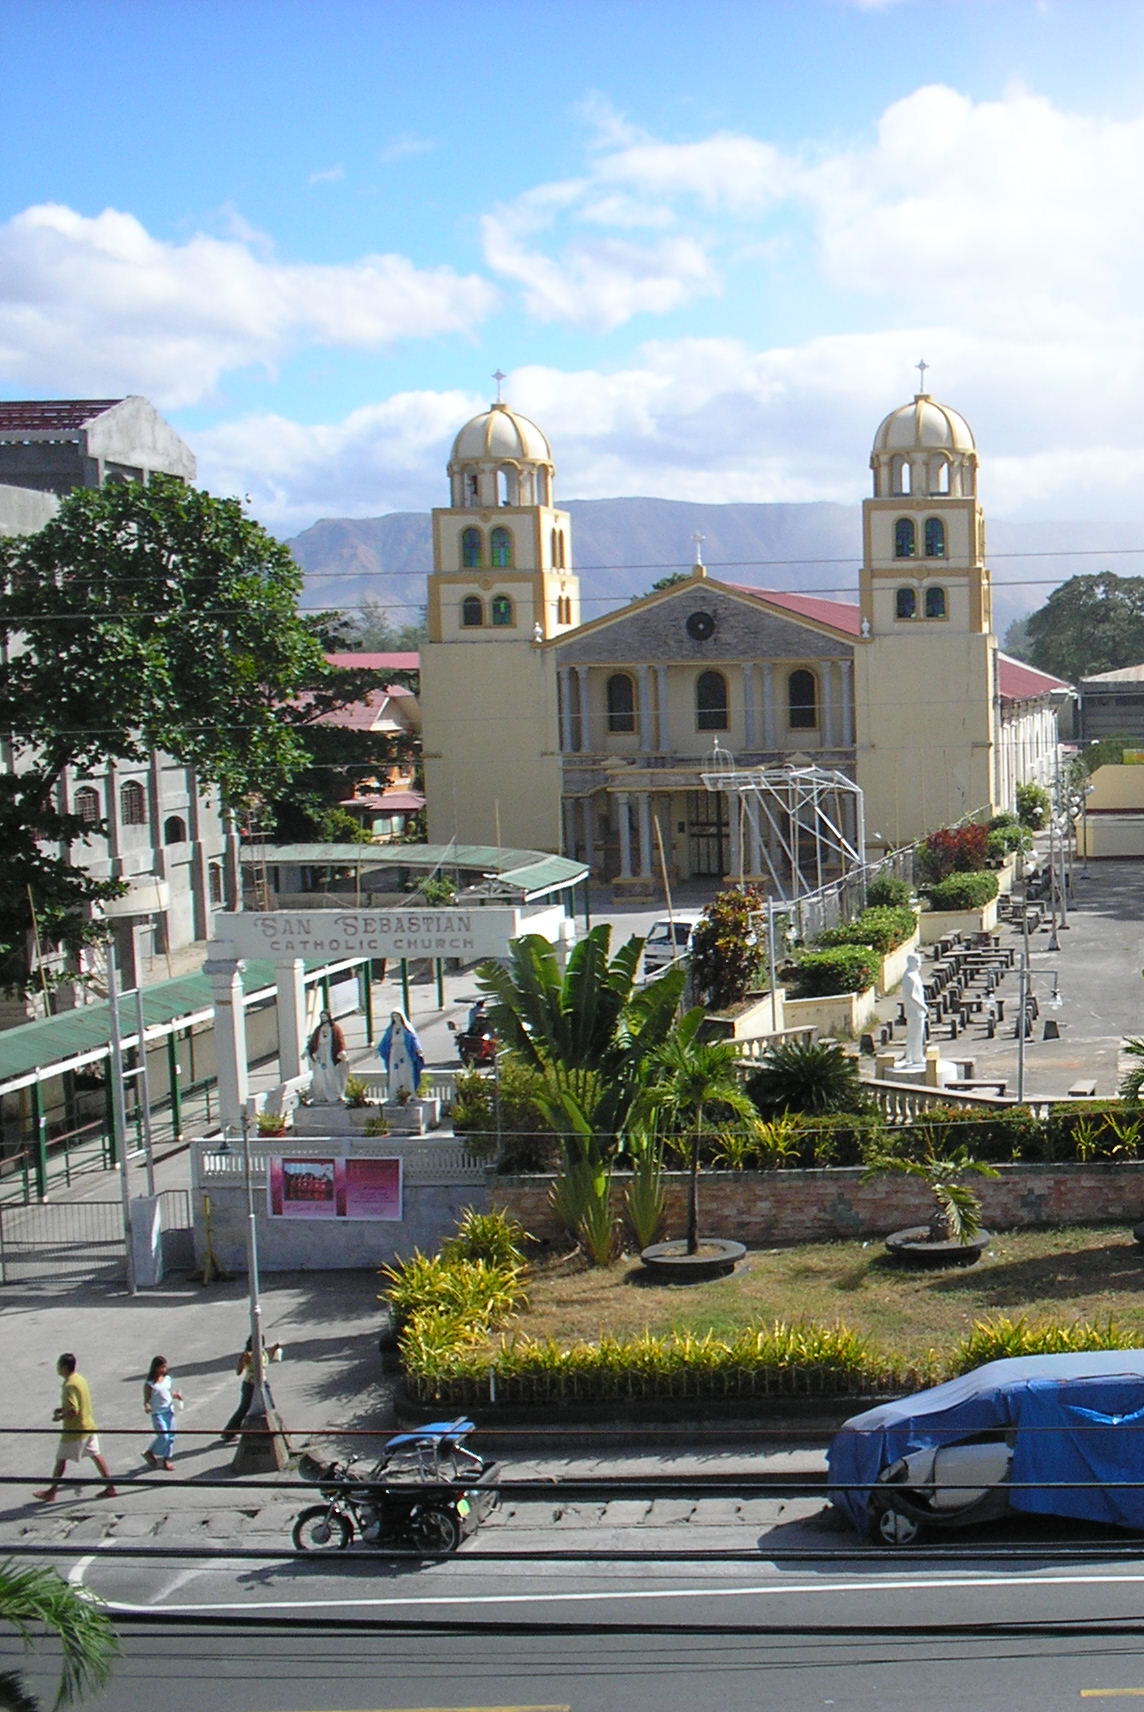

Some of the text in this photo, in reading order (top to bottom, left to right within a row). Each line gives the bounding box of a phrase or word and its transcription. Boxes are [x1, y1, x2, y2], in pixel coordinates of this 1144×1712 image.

[254, 916, 471, 938] SAN SEBASTIAN
[270, 938, 474, 951] CATHOLIC CHURCH
